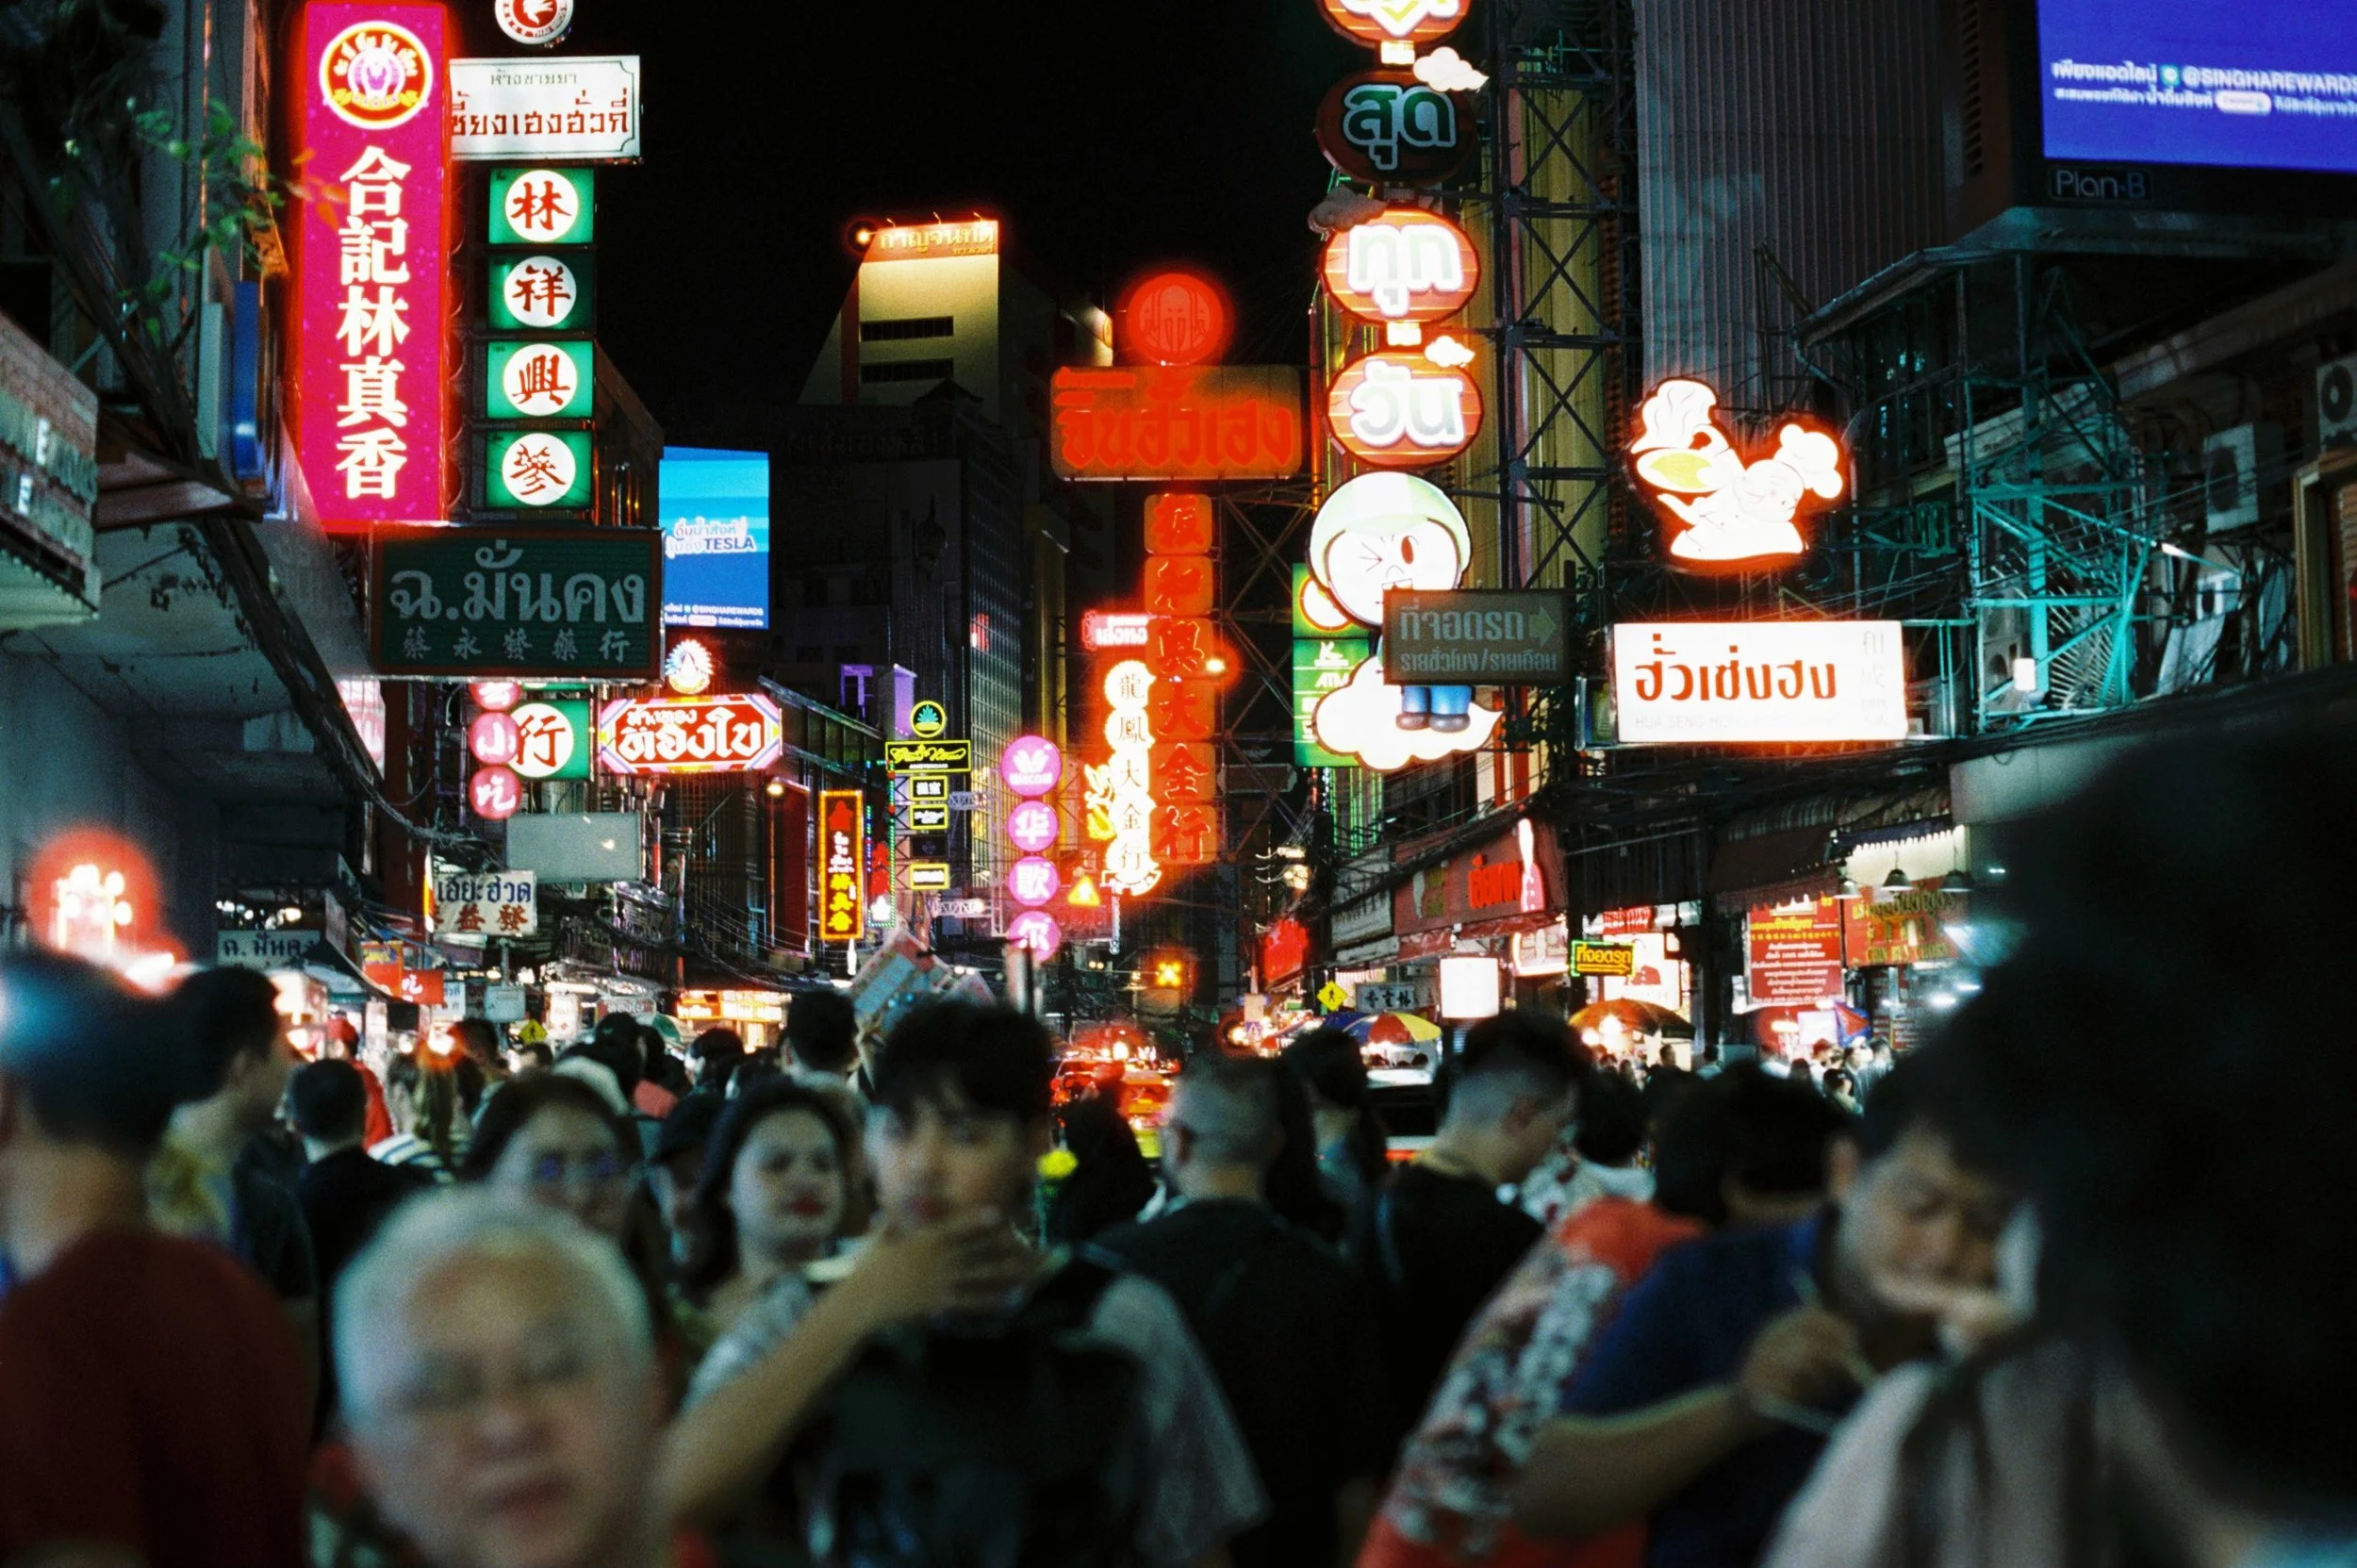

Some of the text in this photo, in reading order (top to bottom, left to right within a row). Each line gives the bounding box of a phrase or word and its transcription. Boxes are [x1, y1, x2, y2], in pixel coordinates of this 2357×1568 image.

[1345, 86, 1455, 169] สุด
[1351, 226, 1459, 314] ทุก
[336, 146, 411, 498] 合記林真香
[1351, 363, 1463, 446] วัน
[390, 539, 645, 622] ฉ.มั่นคง
[704, 537, 754, 550] TESLA
[1400, 598, 1524, 640] ที่จอดรถ
[1635, 634, 1836, 701] ฮั่วเซ่งฮง
[1576, 943, 1632, 963] ที่จอดรถ
